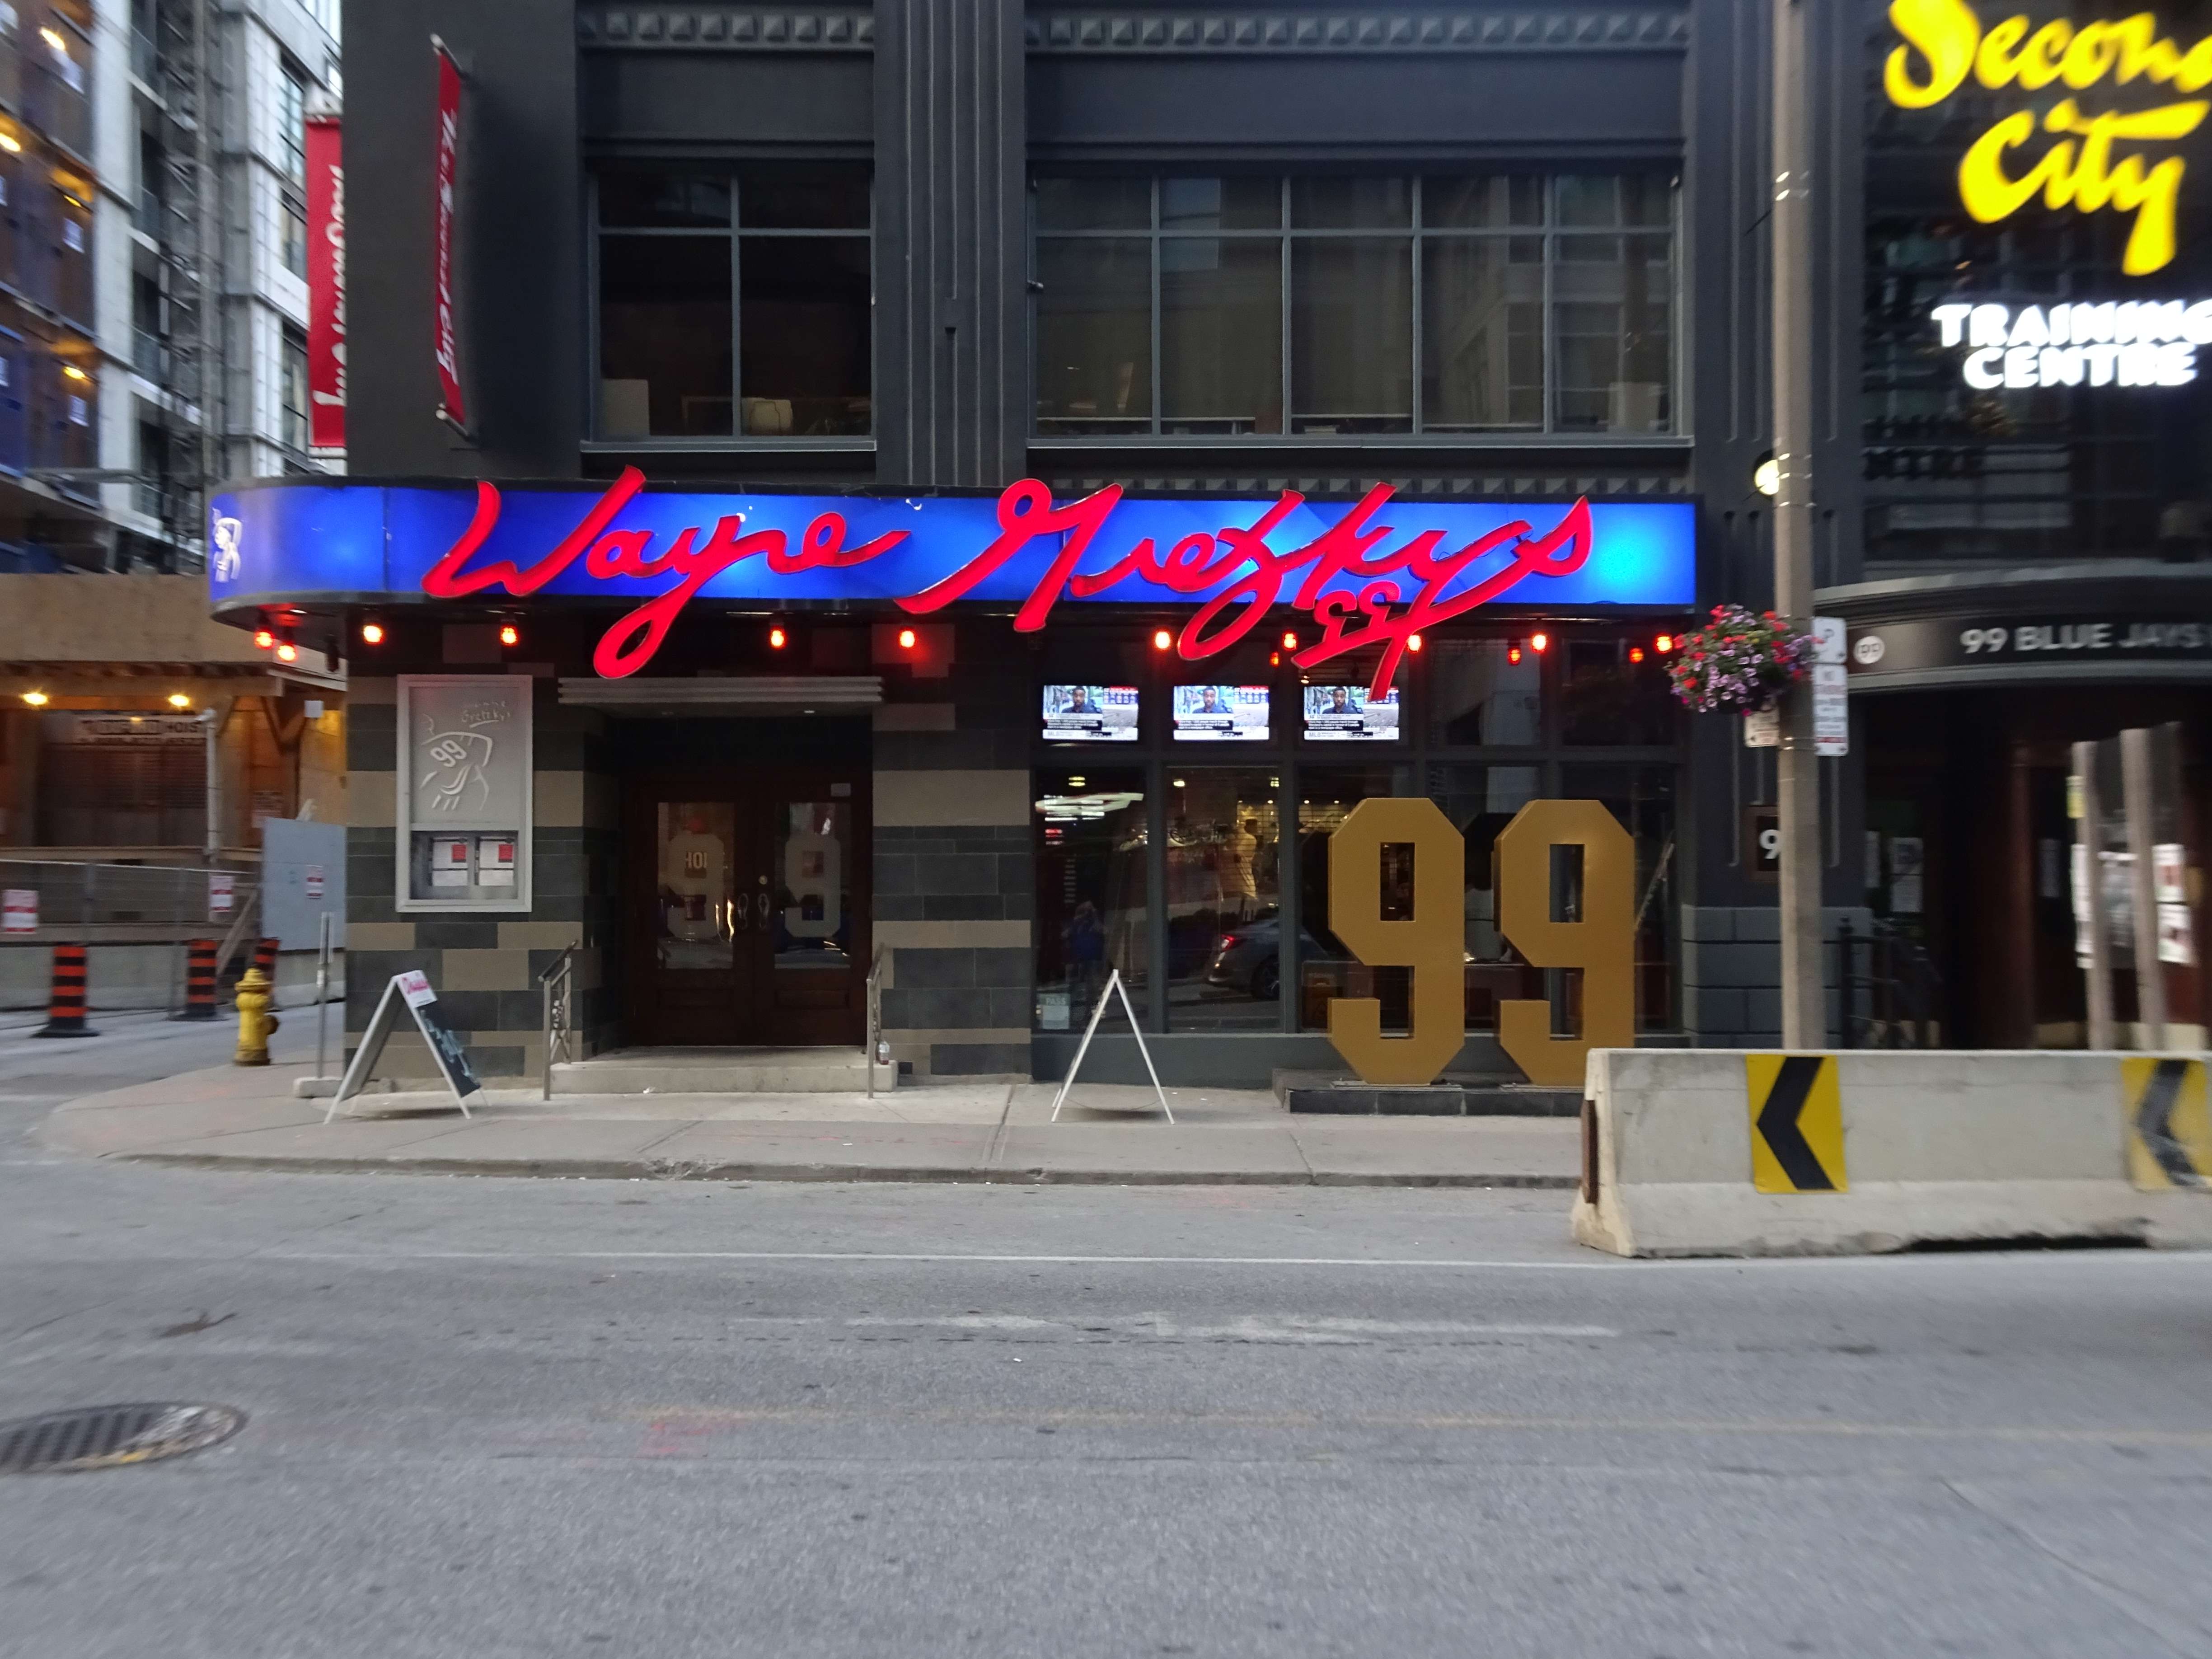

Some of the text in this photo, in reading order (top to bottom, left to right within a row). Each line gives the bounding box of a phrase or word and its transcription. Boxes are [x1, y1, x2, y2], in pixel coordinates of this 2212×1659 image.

[1958, 98, 2212, 276] City
[1931, 298, 2212, 347] TRAINING
[1963, 343, 2199, 389] CENTRE
[421, 465, 911, 679] Wayne
[1959, 623, 2204, 654] 99 BLUE JAYS
[430, 739, 467, 768] 99
[1327, 797, 1635, 1086] 99
